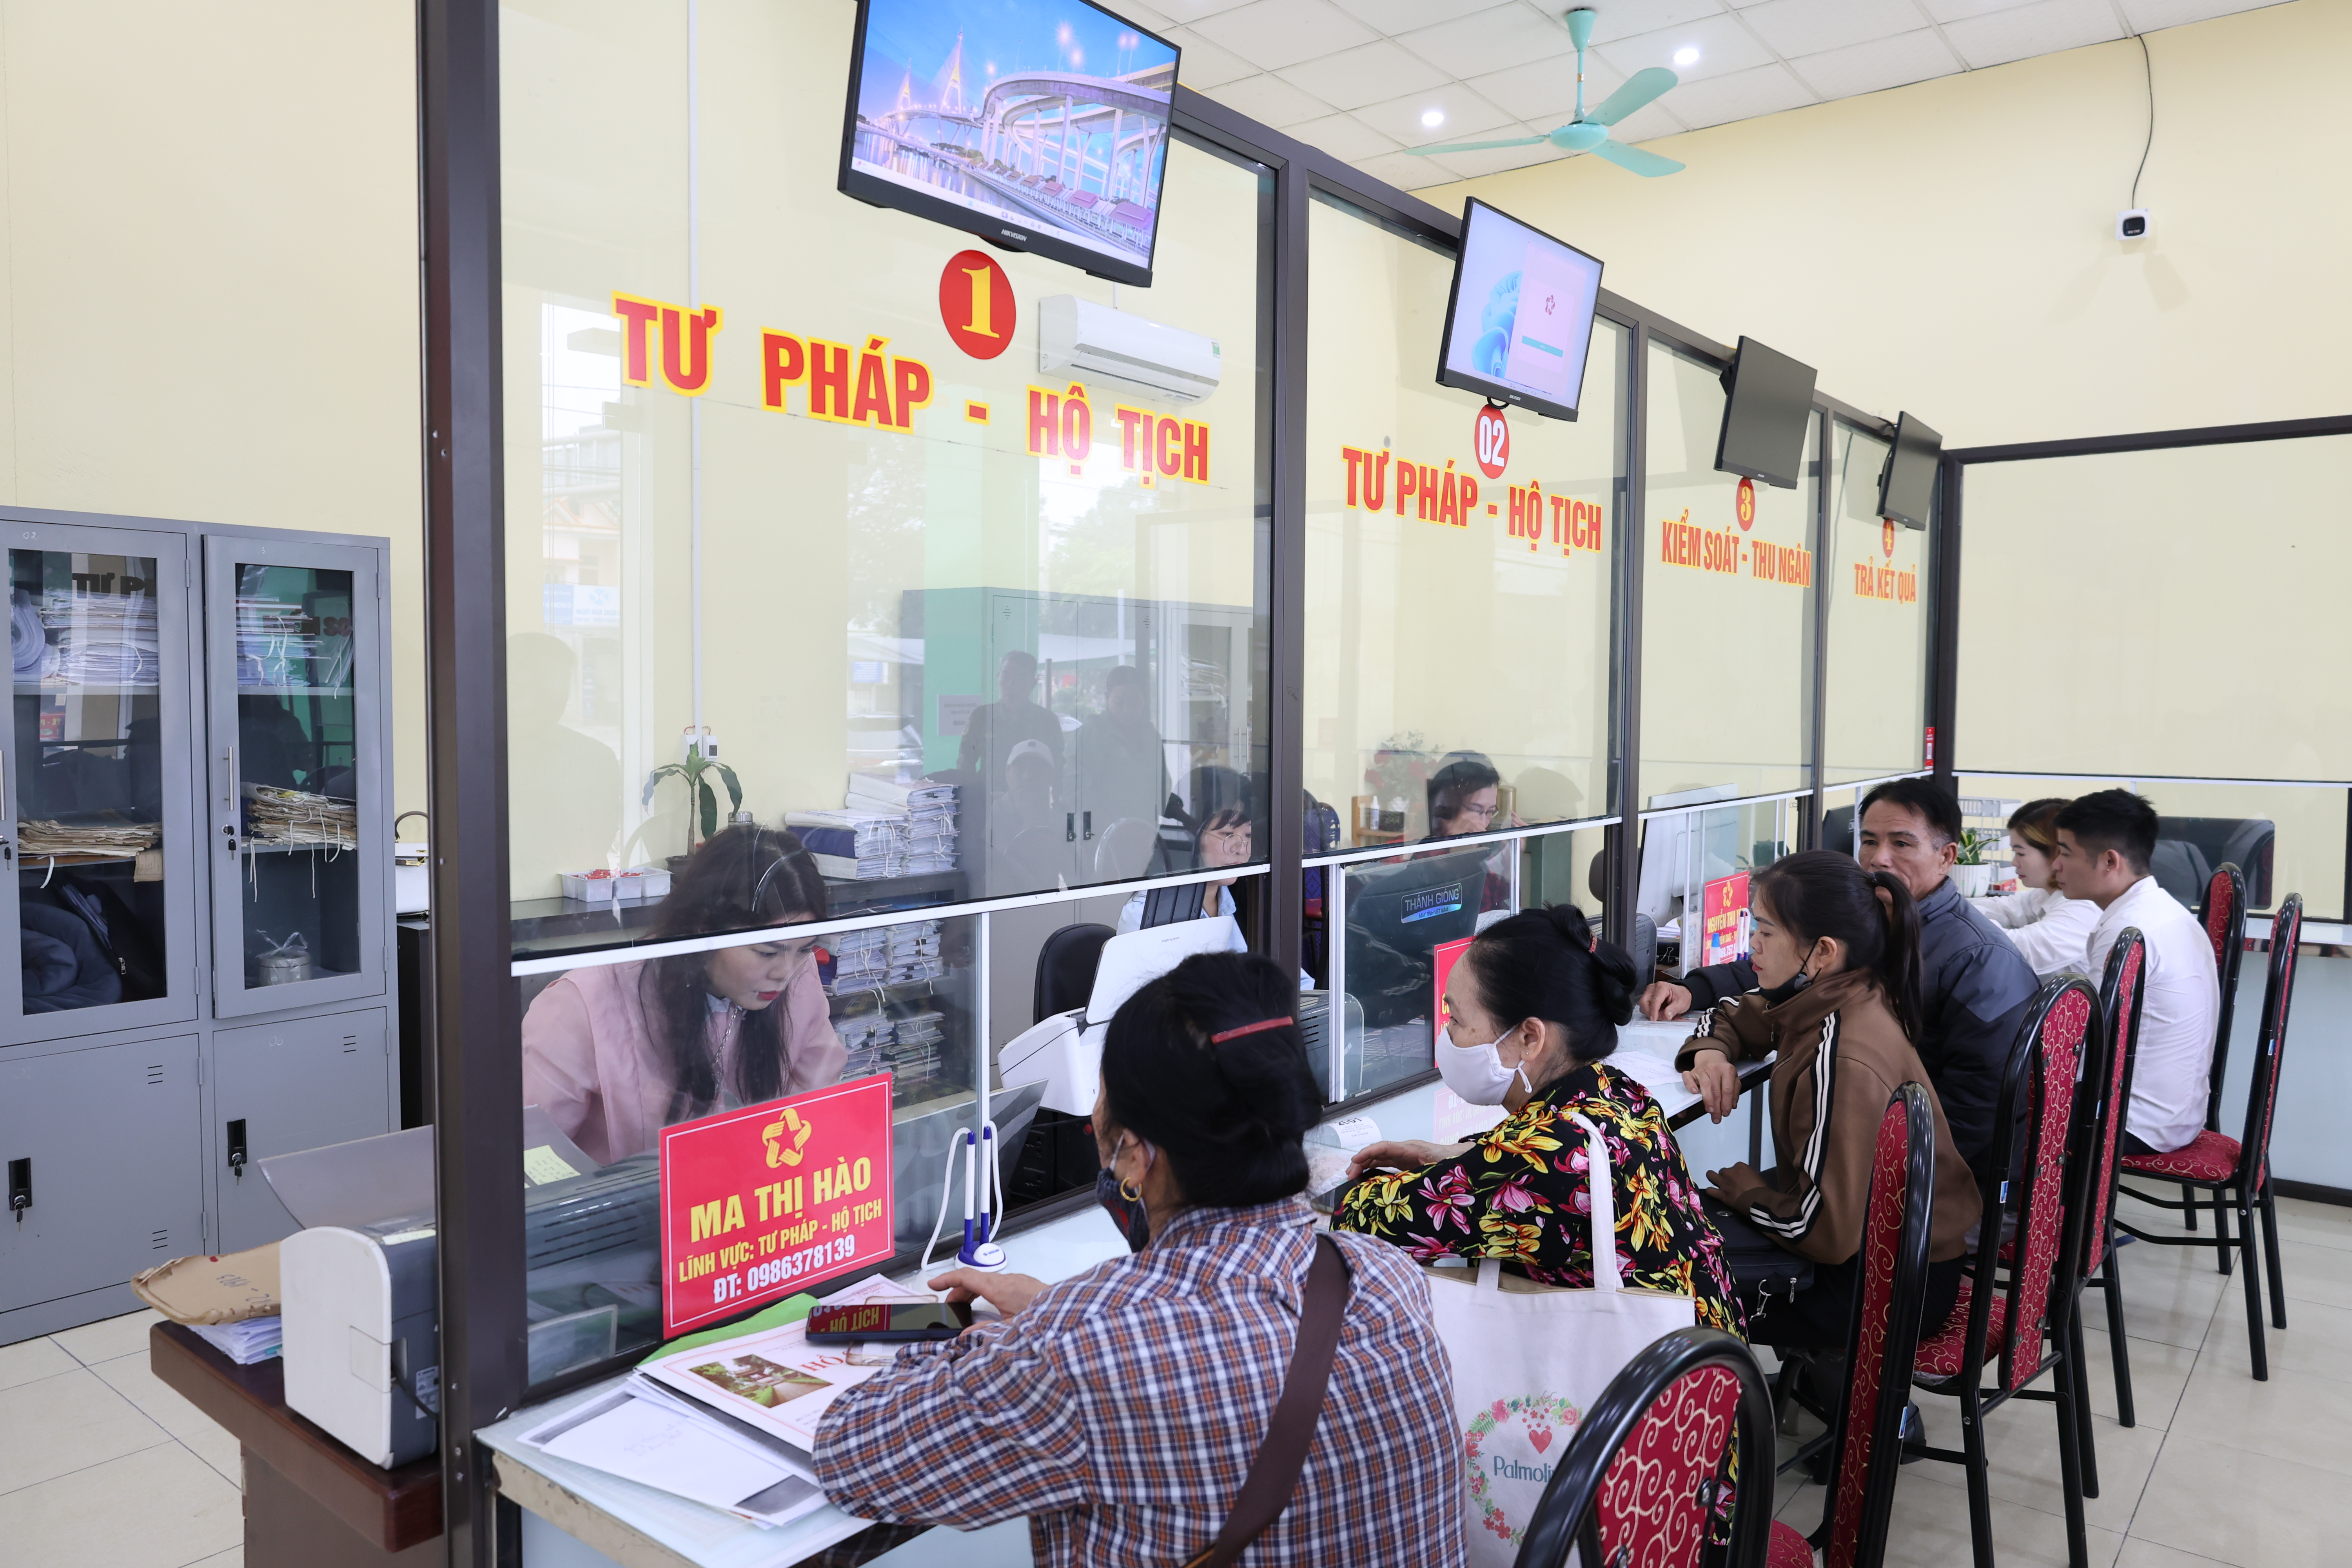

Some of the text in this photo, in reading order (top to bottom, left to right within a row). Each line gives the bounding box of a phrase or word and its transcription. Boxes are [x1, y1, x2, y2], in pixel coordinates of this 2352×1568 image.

[1001, 229, 1027, 242] HIKVISION
[962, 265, 1000, 338] 1
[612, 290, 723, 397] TƯ
[761, 327, 934, 434] PHÁP
[1027, 381, 1093, 479] HỘ
[1115, 403, 1210, 489] TỊCH
[1479, 416, 1505, 467] 02
[1341, 445, 1390, 514] TƯ
[1395, 457, 1479, 529] PHÁP
[1508, 479, 1543, 553] HỘ
[1550, 493, 1602, 558] TỊCH
[1740, 486, 1751, 521] 3
[1662, 507, 1702, 570] KIỂM
[1704, 525, 1740, 575] SOÁT
[1751, 539, 1776, 581] THU
[1778, 541, 1811, 588] NGÂN
[1885, 522, 1893, 550] 4
[1854, 555, 1916, 605] TRẢ KẾT QUẢ
[1405, 888, 1459, 911] THÁNH GIÓNG
[1707, 909, 1726, 934] NGUYỄN
[1727, 910, 1736, 927] THU
[690, 1156, 871, 1243] MA THỊ HÀO
[679, 1255, 716, 1283] LĨNH
[719, 1241, 755, 1269] VỰC:
[758, 1234, 778, 1257] TƯ
[780, 1218, 818, 1249] PHÁP
[831, 1205, 849, 1234] HỘ
[853, 1198, 882, 1228] TỊCH
[713, 1234, 855, 1303] ĐT: 0986378139
[1494, 1455, 1555, 1483] Palmoli
